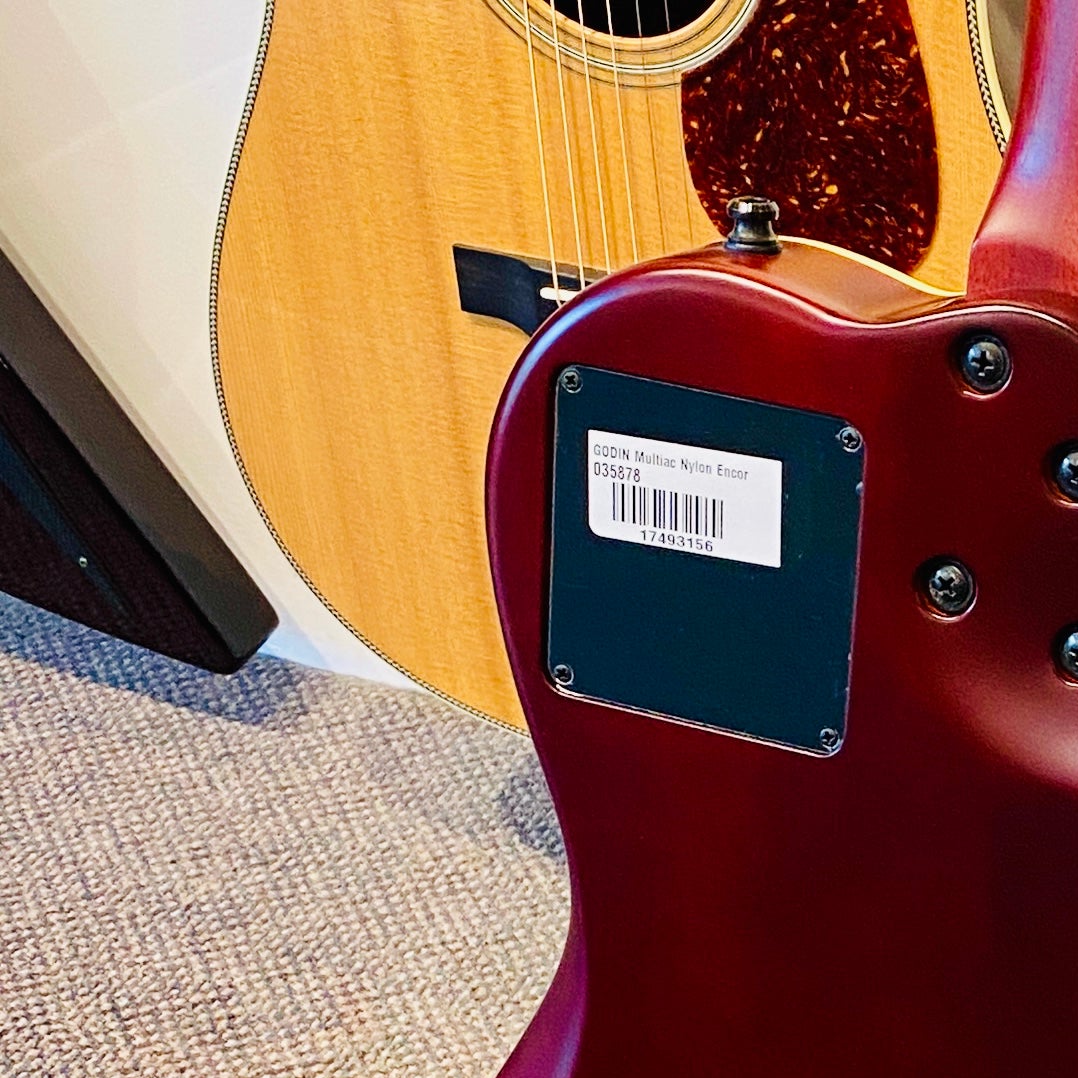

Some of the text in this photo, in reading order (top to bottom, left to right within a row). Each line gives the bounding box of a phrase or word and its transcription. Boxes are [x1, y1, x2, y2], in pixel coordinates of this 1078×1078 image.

[593, 444, 749, 481] GODIN Multiac Nylon Encor
[593, 462, 641, 483] 035878
[641, 530, 714, 552] 17493156
